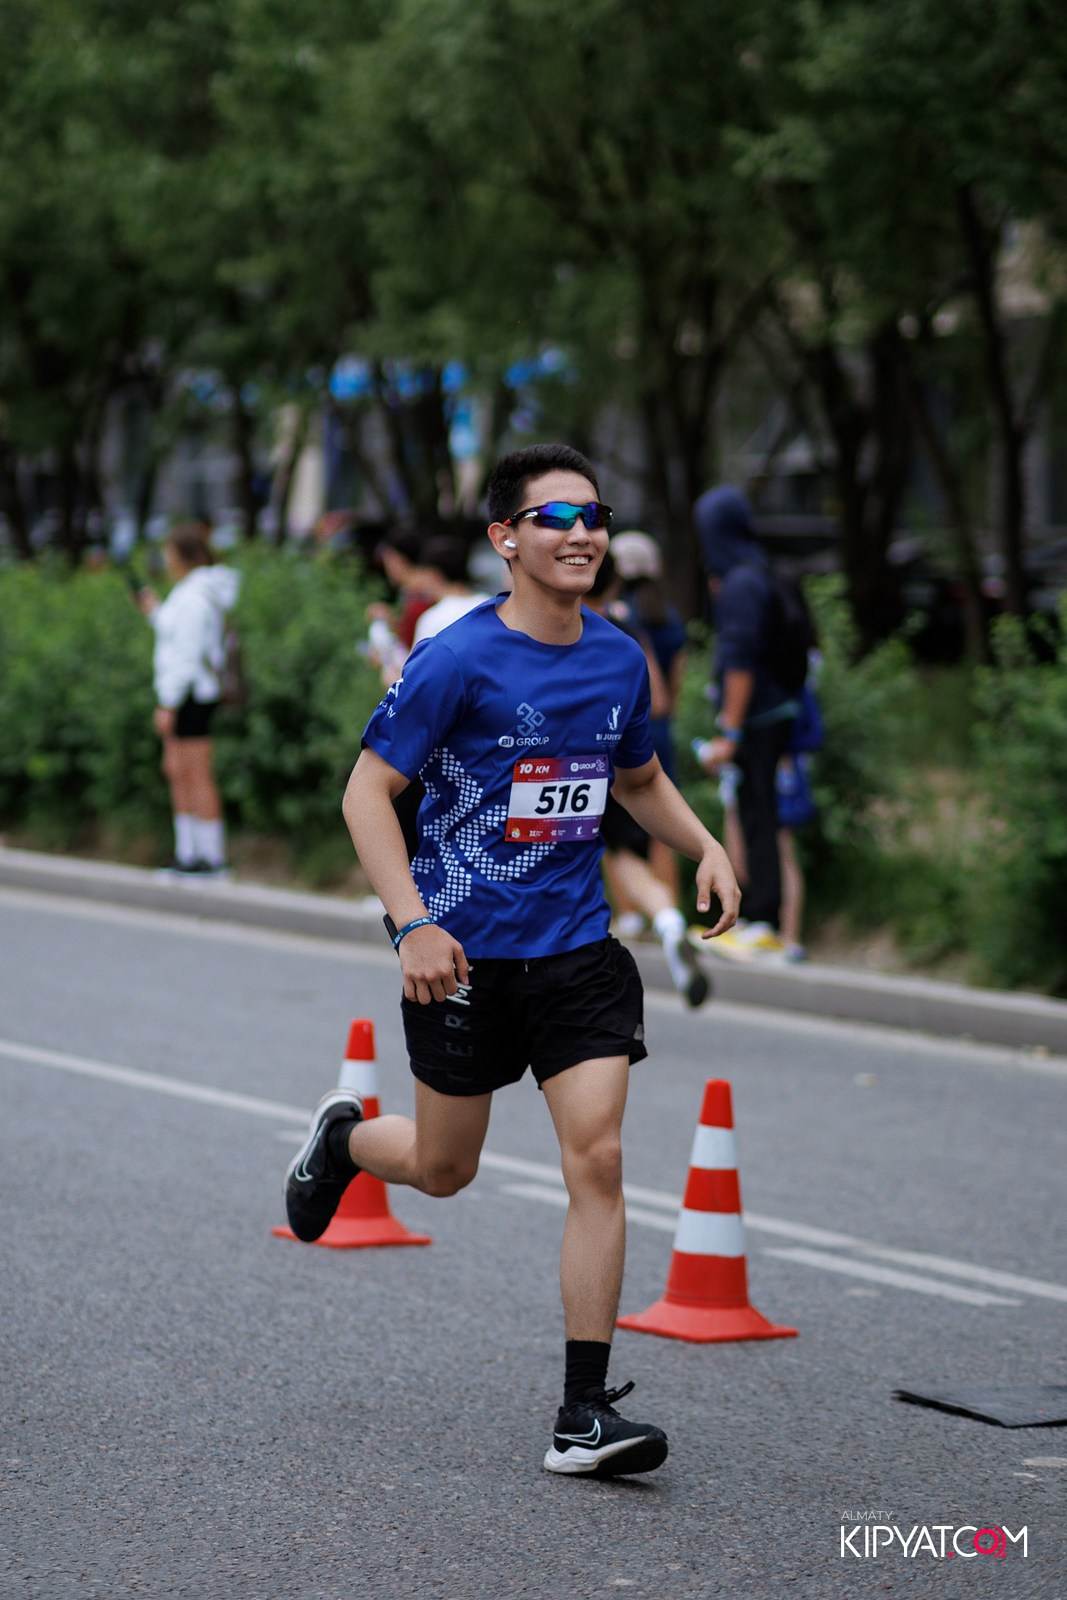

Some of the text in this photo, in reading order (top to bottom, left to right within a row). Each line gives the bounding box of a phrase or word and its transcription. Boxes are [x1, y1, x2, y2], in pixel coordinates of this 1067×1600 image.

[516, 736, 550, 746] GROUP
[519, 763, 550, 774] 10 KM
[534, 783, 591, 815] 516
